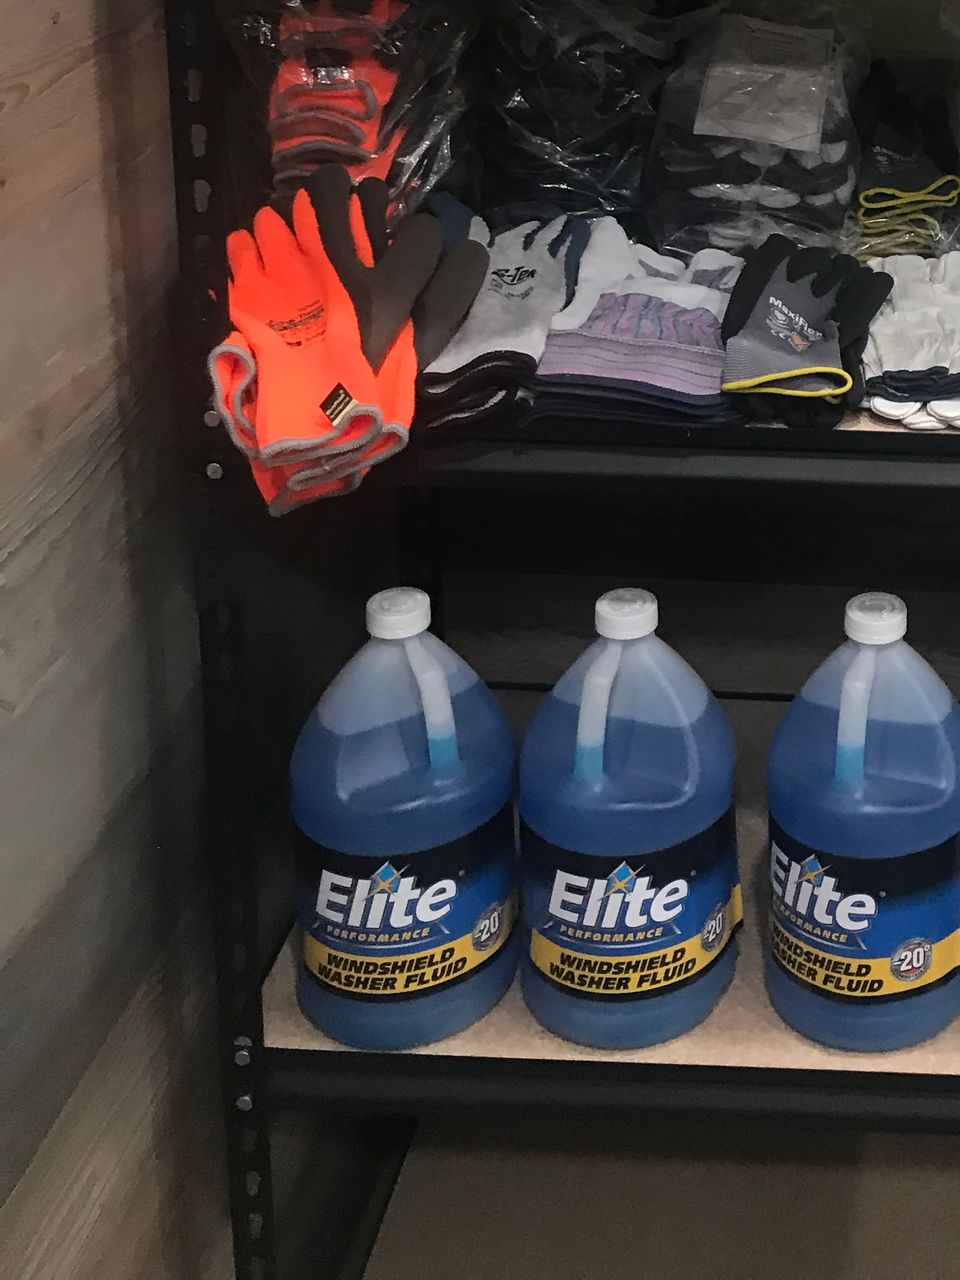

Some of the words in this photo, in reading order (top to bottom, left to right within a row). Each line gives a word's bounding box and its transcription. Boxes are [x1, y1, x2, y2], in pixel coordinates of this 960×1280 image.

[769, 296, 823, 337] MaxiFlex
[315, 867, 457, 930] Elite
[548, 868, 690, 929] Elite
[770, 840, 877, 932] Elite
[326, 925, 431, 943] PERFORMANCE
[559, 924, 663, 943] PERFORMANCE
[318, 963, 397, 991] WASHER
[403, 957, 468, 989] FLUID
[326, 947, 455, 976] WINDSHIELD
[549, 962, 629, 991] WASHER
[636, 957, 697, 989] FLUID
[559, 947, 686, 976] WINDSHIELD
[773, 945, 819, 982] ASHER
[822, 973, 884, 993] FLUID
